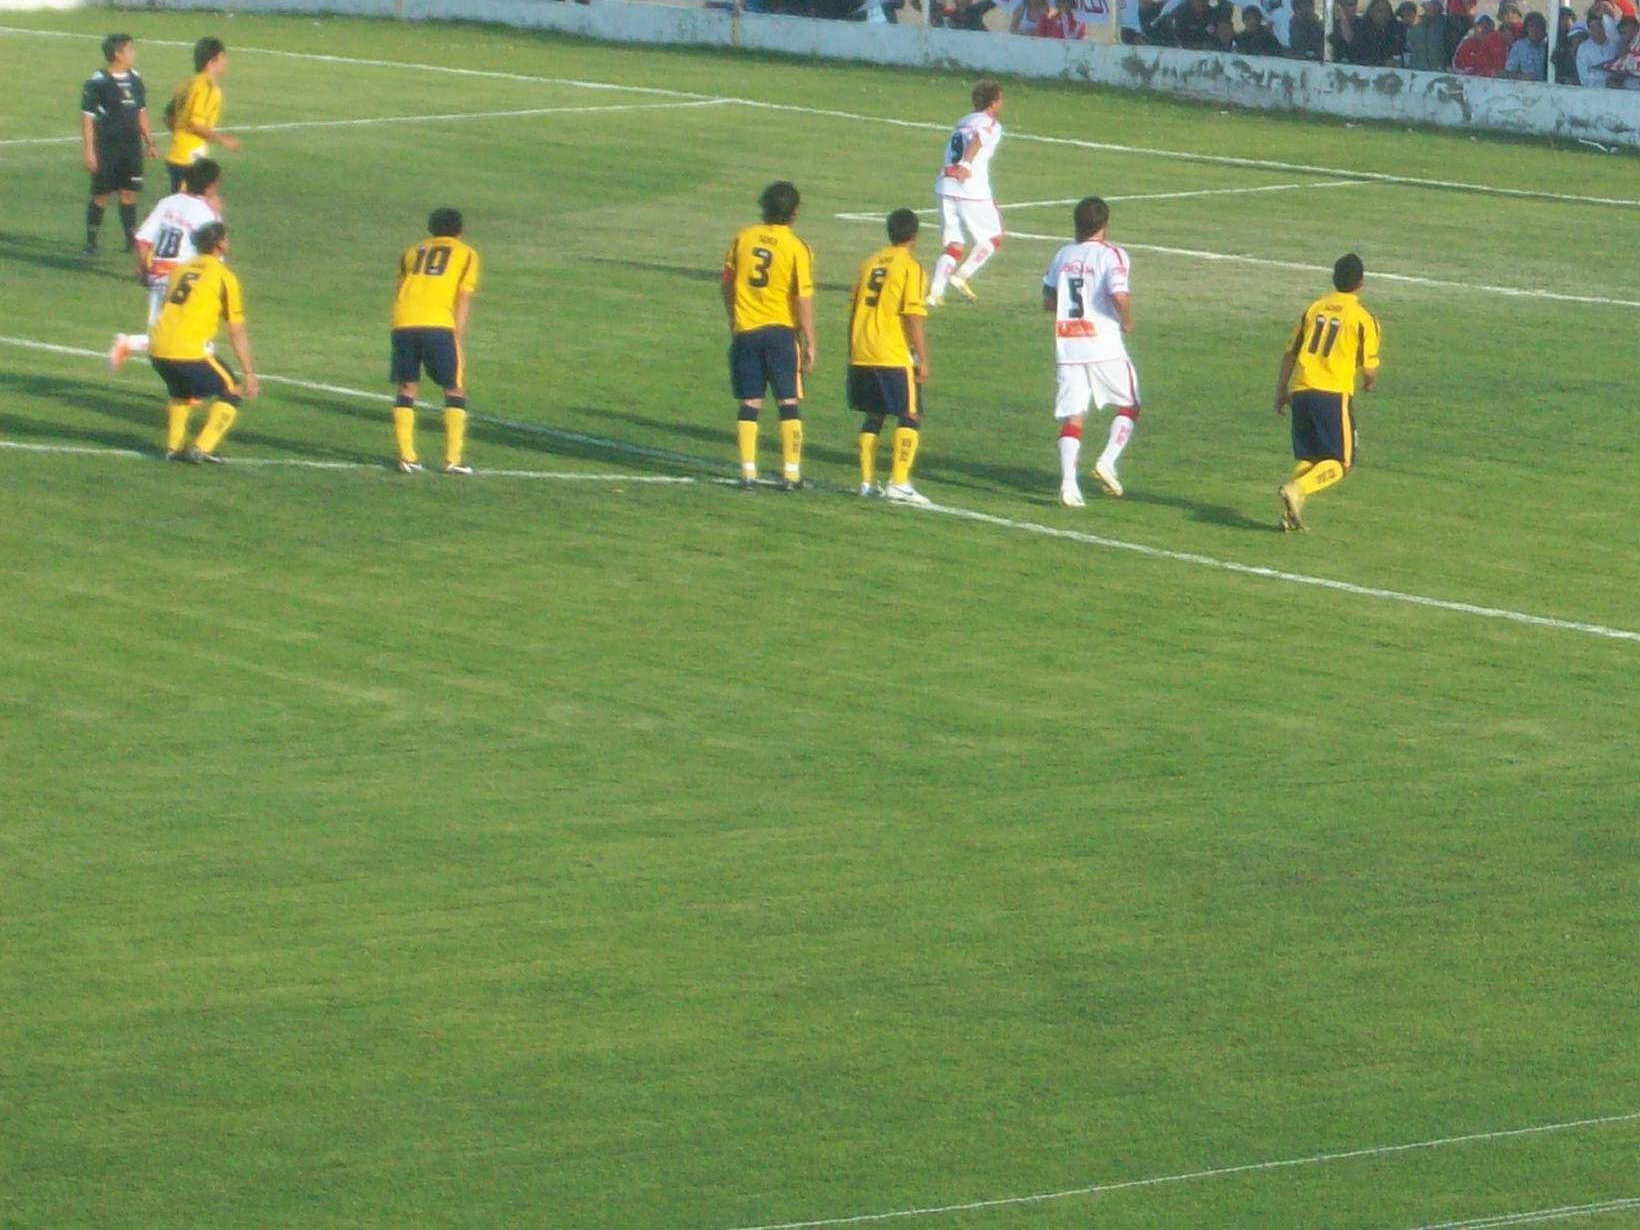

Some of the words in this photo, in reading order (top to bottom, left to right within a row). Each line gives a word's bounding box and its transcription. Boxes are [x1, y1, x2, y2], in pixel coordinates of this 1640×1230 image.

[748, 246, 773, 289] 3
[1068, 278, 1084, 318] 5
[1307, 314, 1341, 358] 11
